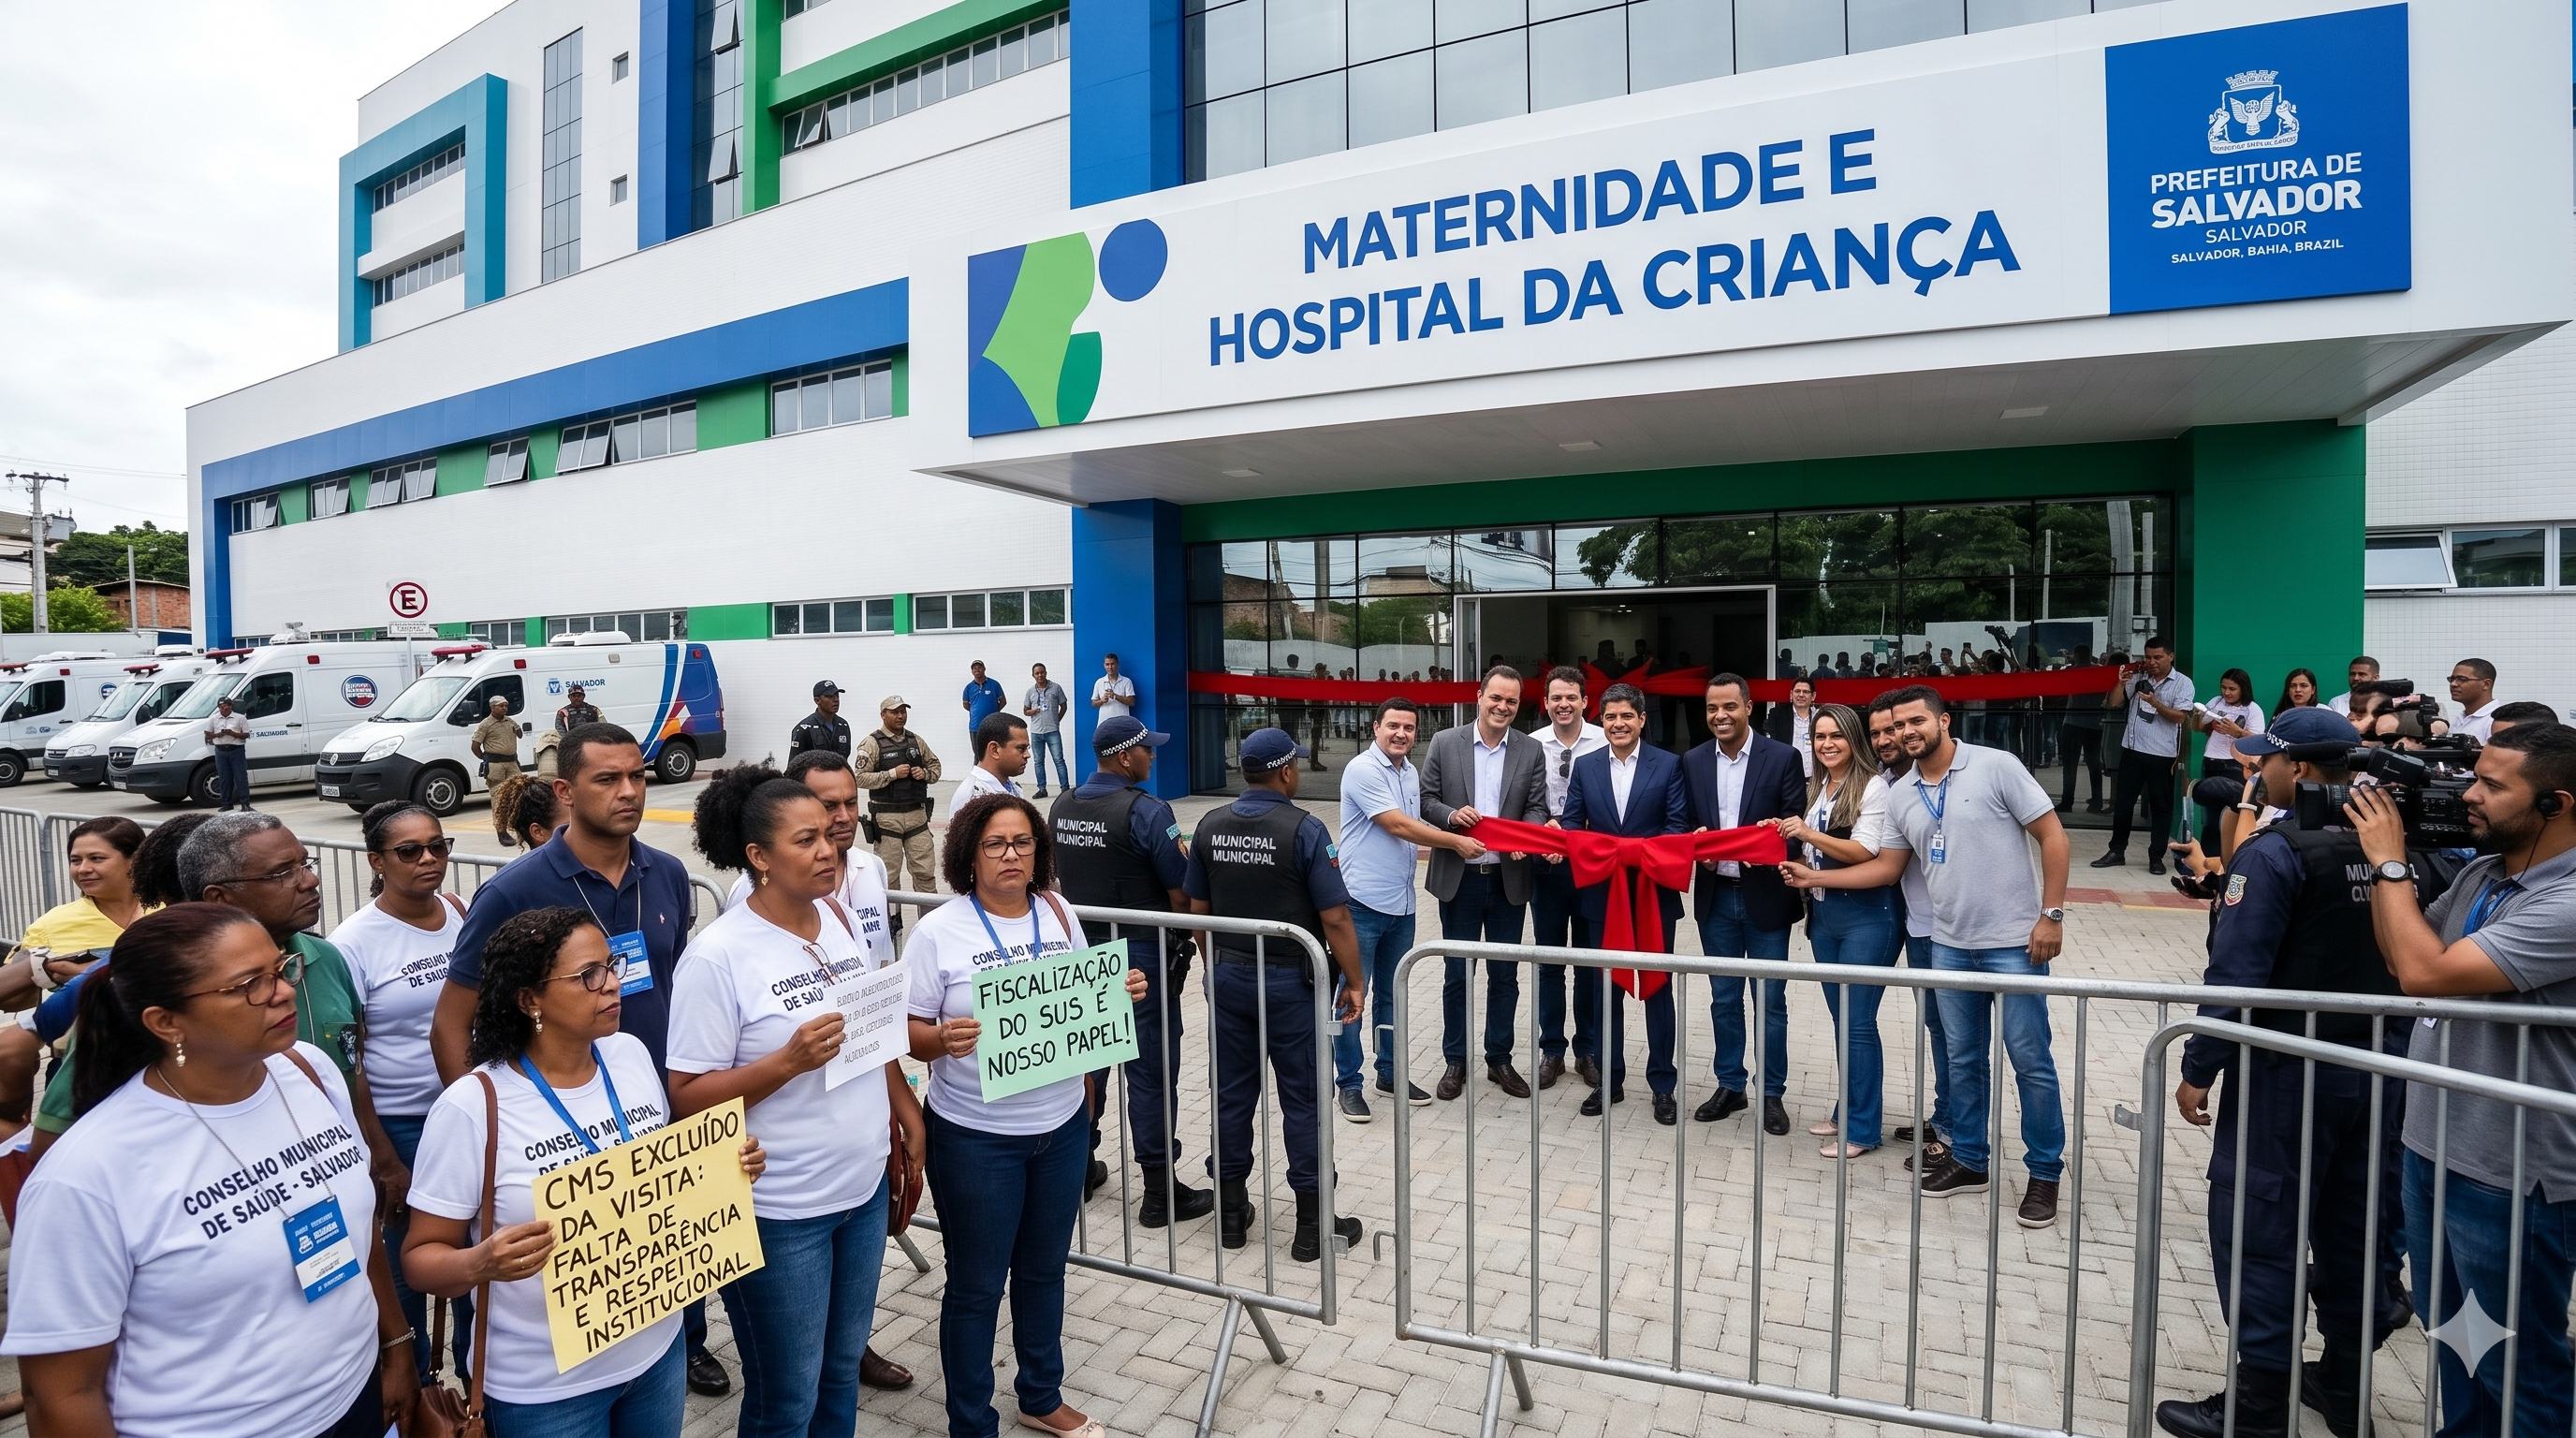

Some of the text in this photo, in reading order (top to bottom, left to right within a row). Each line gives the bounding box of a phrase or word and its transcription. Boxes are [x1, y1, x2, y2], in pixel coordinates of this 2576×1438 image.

[1305, 129, 1877, 273] MATERNIDADE E
[2151, 152, 2363, 194] PREFEITURA DE
[2151, 179, 2364, 228] SALVADOR
[2205, 220, 2307, 243] SALVADOR
[2171, 238, 2344, 264] SALVADOR, BAHIA, BRAZIL
[1211, 211, 2021, 365] HOSPITAL DA CRIANÇA
[1056, 832, 1106, 848] MUNICIPAL
[1057, 818, 1108, 834] MUNICIPAL
[1211, 835, 1277, 850] MUNICIPAL
[1212, 849, 1276, 866] MUNICIPAL
[408, 975, 425, 988] DE
[783, 995, 802, 1011] DE
[999, 982, 1108, 1040] DO SUS É
[988, 1012, 1132, 1081] NOSSO PAPEL!
[183, 1124, 353, 1216] CONSELHO MUNICIPAL
[546, 1159, 615, 1210] CMS
[632, 1111, 739, 1177] EXCLUÍDO
[201, 1212, 232, 1240] DE
[232, 1182, 292, 1225] SAÚDE
[562, 1165, 703, 1243] DA VISITA:
[552, 1203, 741, 1308] TRANSPARÊNCIA
[554, 1204, 677, 1279] FALTA DE
[576, 1242, 713, 1328] E RESPEITO
[586, 1252, 751, 1354] INSTITUCIONAL
